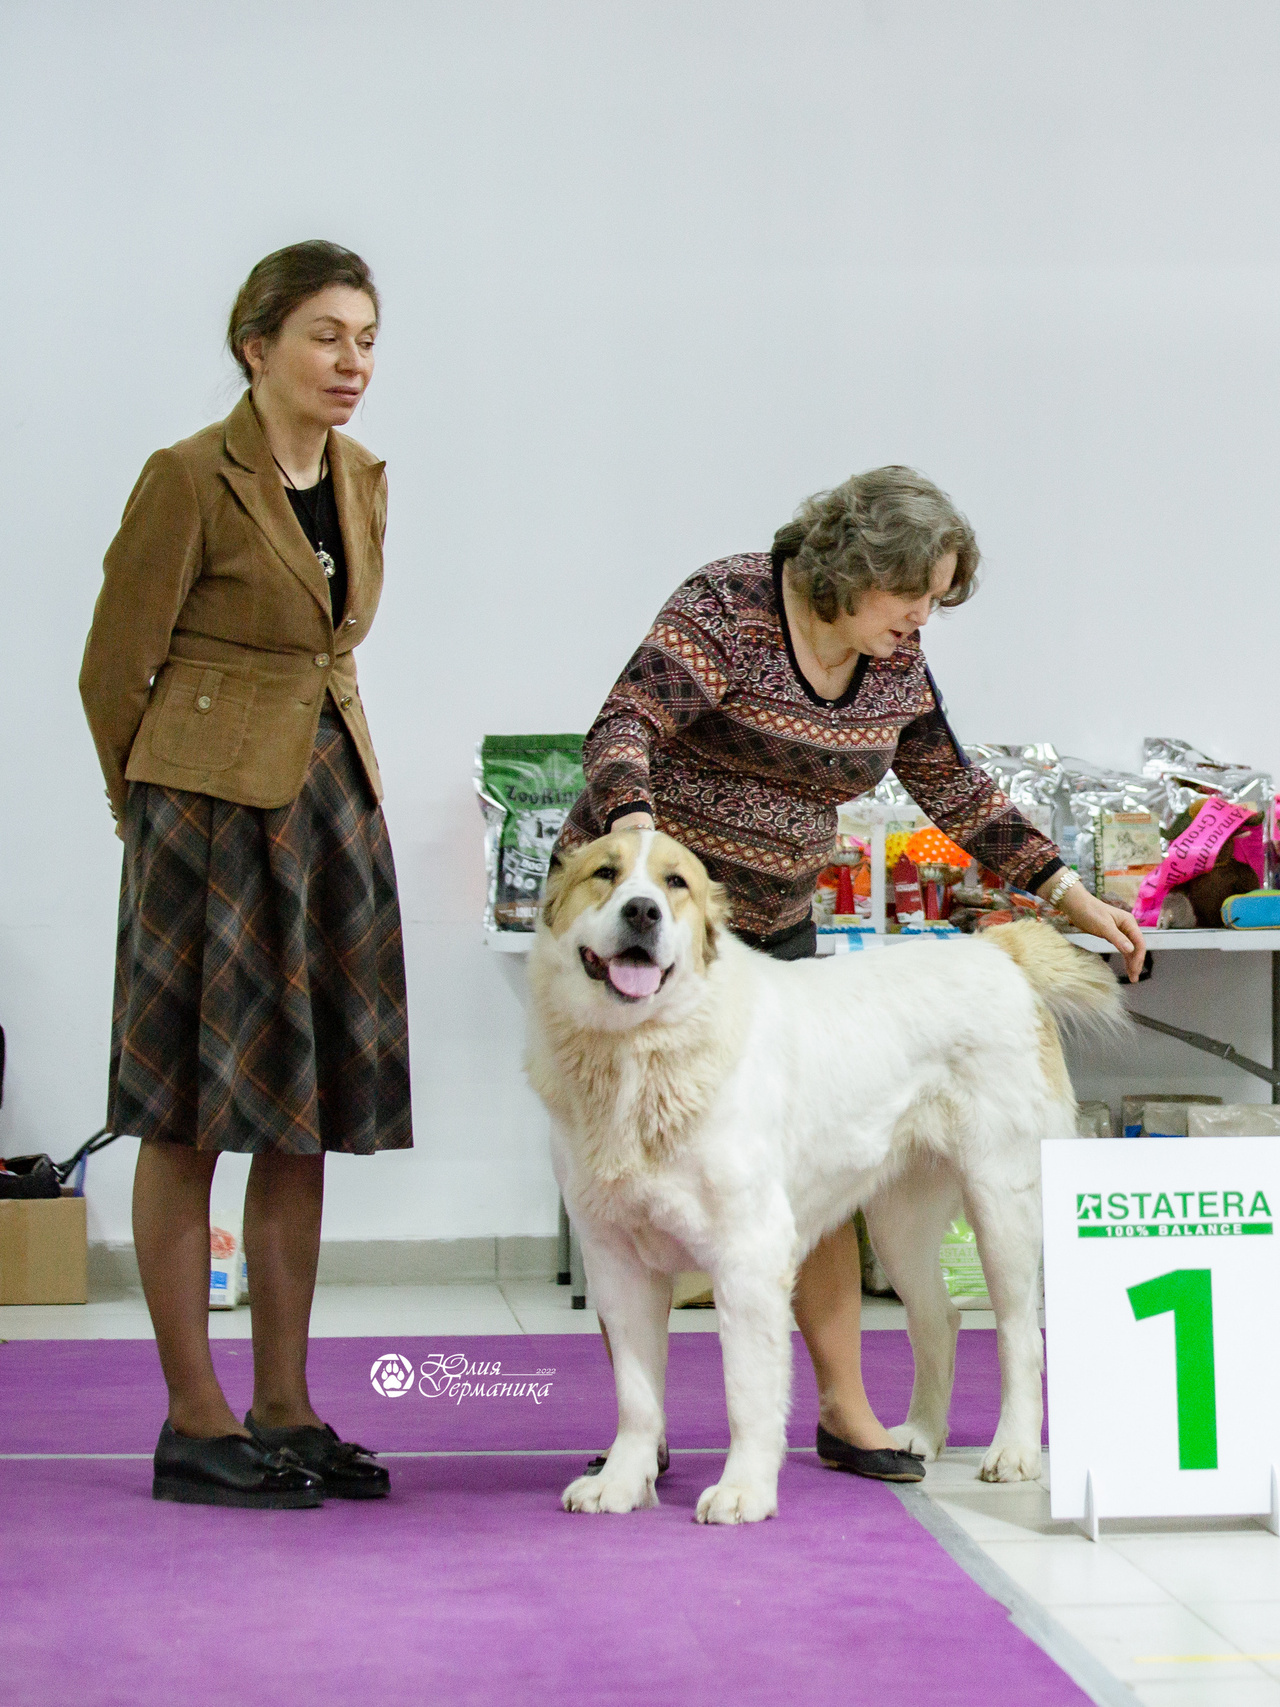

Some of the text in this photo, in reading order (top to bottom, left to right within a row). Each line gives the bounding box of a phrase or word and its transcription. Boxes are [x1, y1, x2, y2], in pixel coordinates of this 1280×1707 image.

[1173, 813, 1217, 860] Group
[1107, 1190, 1272, 1220] STATERA
[1106, 1223, 1243, 1237] 100% BALANCE
[1126, 1268, 1218, 1470] 1
